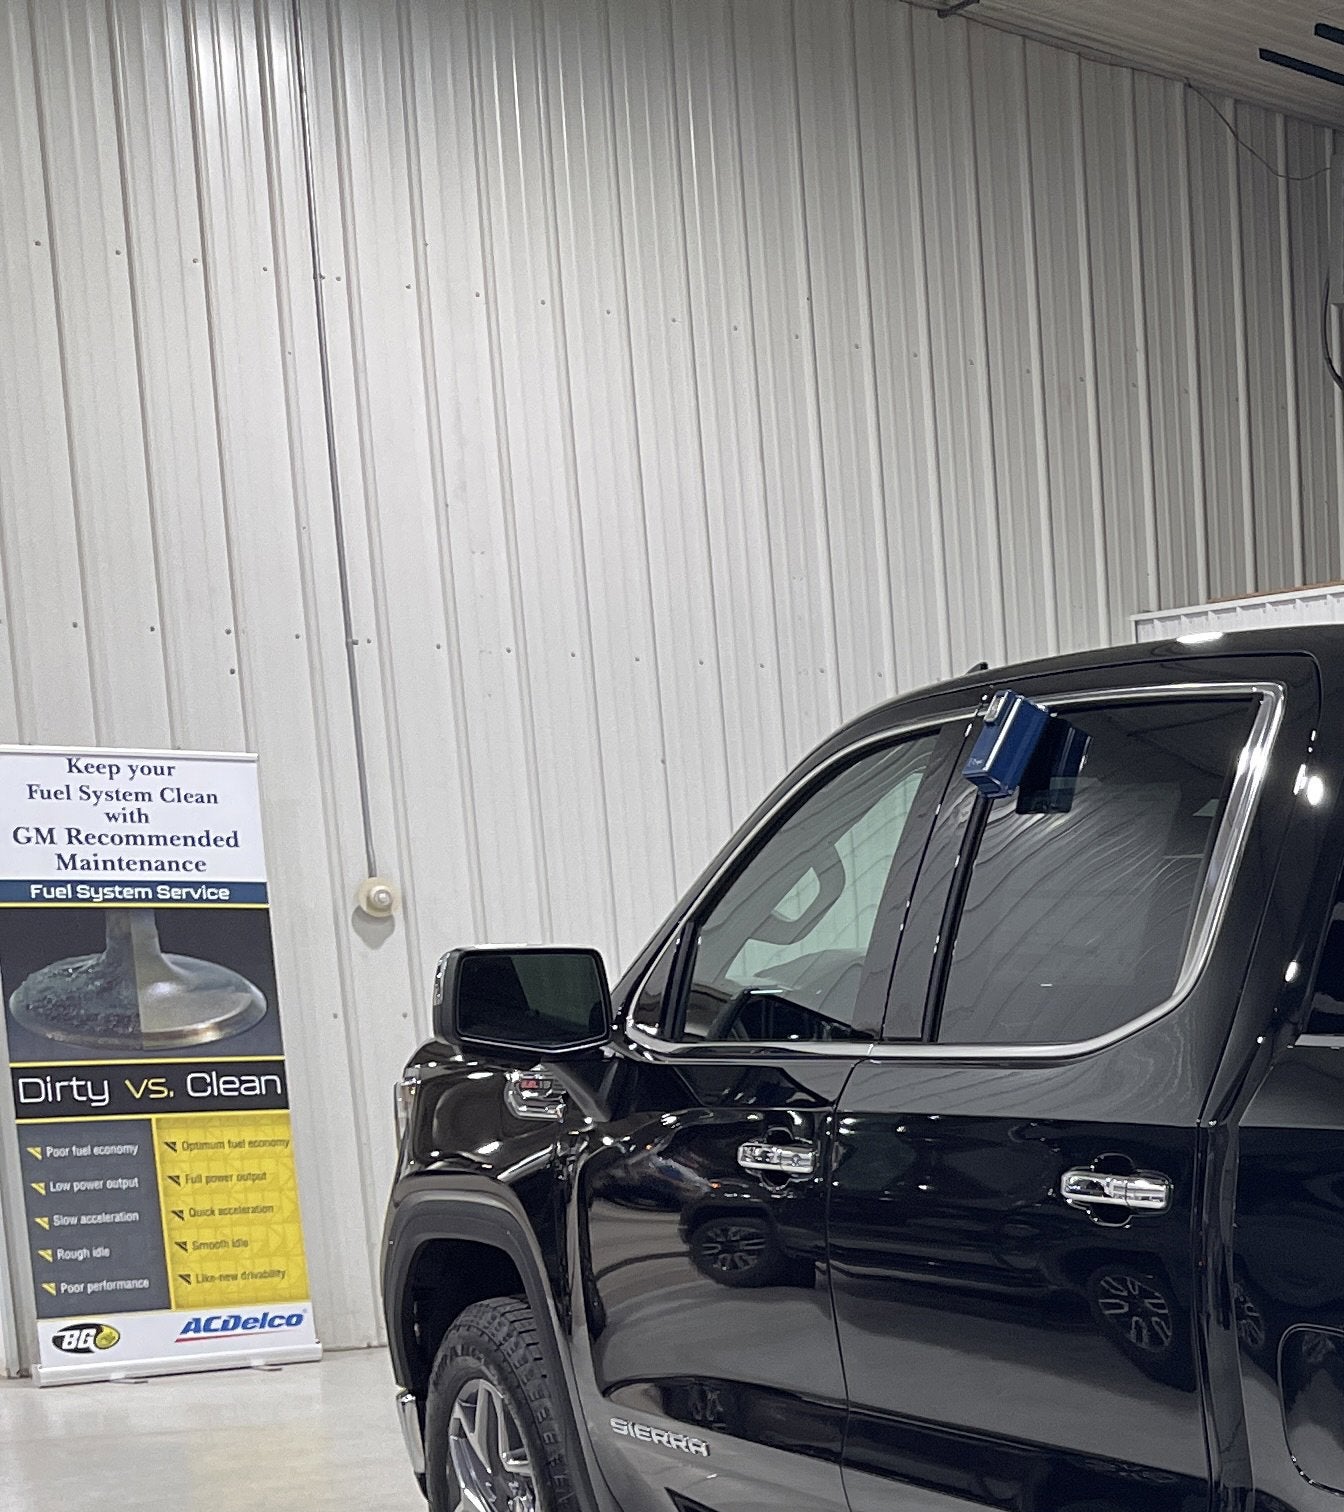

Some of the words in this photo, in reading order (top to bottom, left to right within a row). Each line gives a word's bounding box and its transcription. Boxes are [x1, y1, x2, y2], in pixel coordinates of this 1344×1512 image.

[66, 758, 121, 780] Keep
[128, 763, 176, 781] your
[26, 783, 71, 801] Fuel
[79, 785, 153, 806] System
[160, 787, 219, 805] Clean
[104, 808, 150, 824] with
[12, 827, 57, 845] GM
[65, 827, 240, 848] Recommended
[55, 853, 208, 872] Maintenance
[30, 884, 72, 899] Fuel
[76, 885, 153, 901] System
[156, 885, 230, 900] Service
[18, 1076, 110, 1107] Dirty
[124, 1078, 175, 1099] vs.
[186, 1071, 282, 1098] Clean
[46, 1146, 69, 1158] Poor
[72, 1144, 91, 1156] fuel
[93, 1143, 139, 1156] economy
[182, 1140, 225, 1152] Optimum
[228, 1139, 245, 1149] fuel
[248, 1138, 290, 1149] economy
[50, 1181, 71, 1193] Low
[73, 1180, 103, 1193] power
[106, 1177, 139, 1190] output
[185, 1174, 202, 1184] Full
[205, 1173, 233, 1185] power
[236, 1171, 267, 1183] output
[53, 1214, 78, 1226] Slow
[80, 1212, 139, 1225] acceleration
[189, 1207, 215, 1218] Quick
[218, 1205, 274, 1216] acceleration
[192, 1240, 229, 1251] Smooth
[232, 1239, 249, 1248] idle
[57, 1248, 90, 1261] Rough
[92, 1247, 110, 1257] idle
[196, 1271, 238, 1284] Like-new
[240, 1269, 286, 1281] drivability
[60, 1282, 84, 1294] Poor
[87, 1279, 150, 1294] performance
[61, 1325, 96, 1350] BG
[180, 1311, 304, 1336] ACDelco
[610, 1417, 709, 1457] SIERRA
